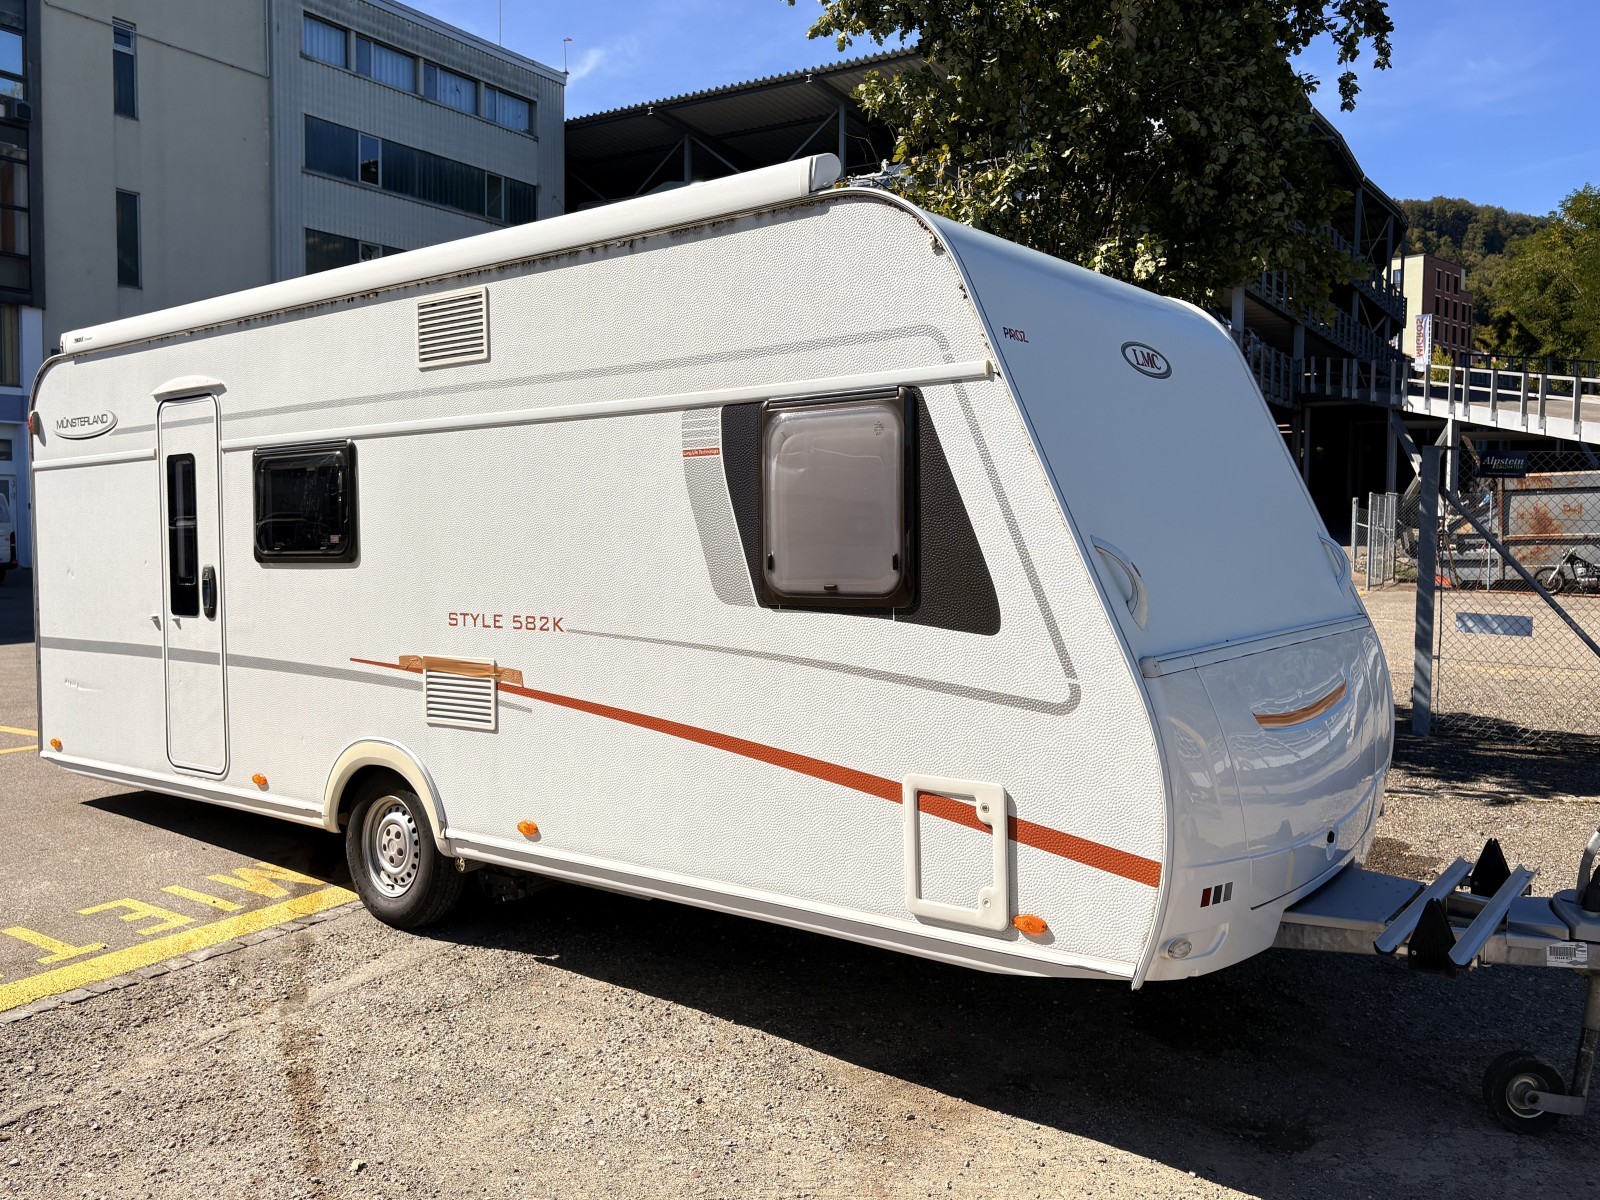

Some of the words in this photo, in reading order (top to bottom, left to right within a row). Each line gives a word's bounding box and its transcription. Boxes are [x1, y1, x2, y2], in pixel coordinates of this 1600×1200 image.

[1131, 348, 1162, 371] LMC
[56, 413, 109, 430] MÜNSTERLAND
[1482, 456, 1525, 469] Alpstein
[448, 612, 504, 629] STYLE
[512, 615, 564, 632] 582K
